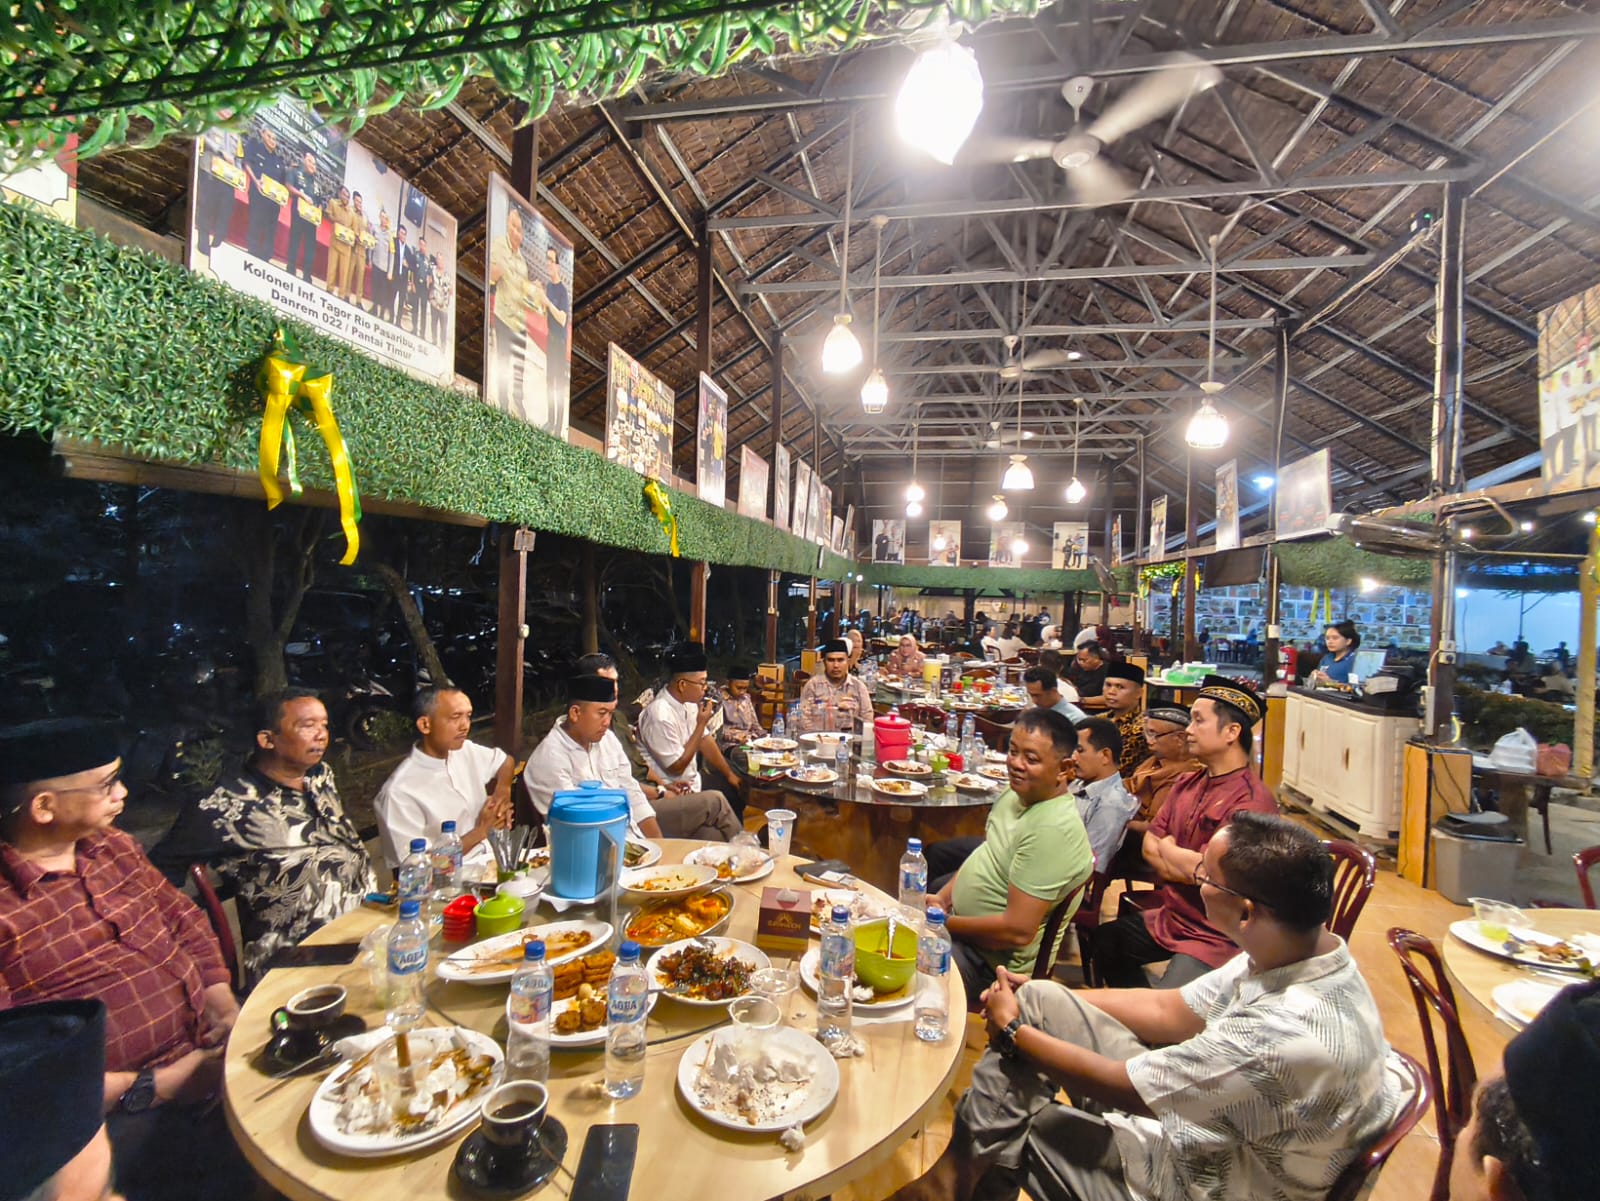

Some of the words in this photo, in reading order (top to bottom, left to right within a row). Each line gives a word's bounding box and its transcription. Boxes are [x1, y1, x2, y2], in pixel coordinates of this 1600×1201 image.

[243, 260, 294, 292] Kolonel
[298, 286, 316, 304] Inf.
[320, 297, 351, 319] Tagor
[354, 314, 371, 329] Rio
[271, 288, 319, 319] Danrem
[322, 312, 343, 330] 022
[352, 326, 383, 347] Pantai
[386, 341, 412, 359] Timur
[610, 999, 637, 1010] AQUA
